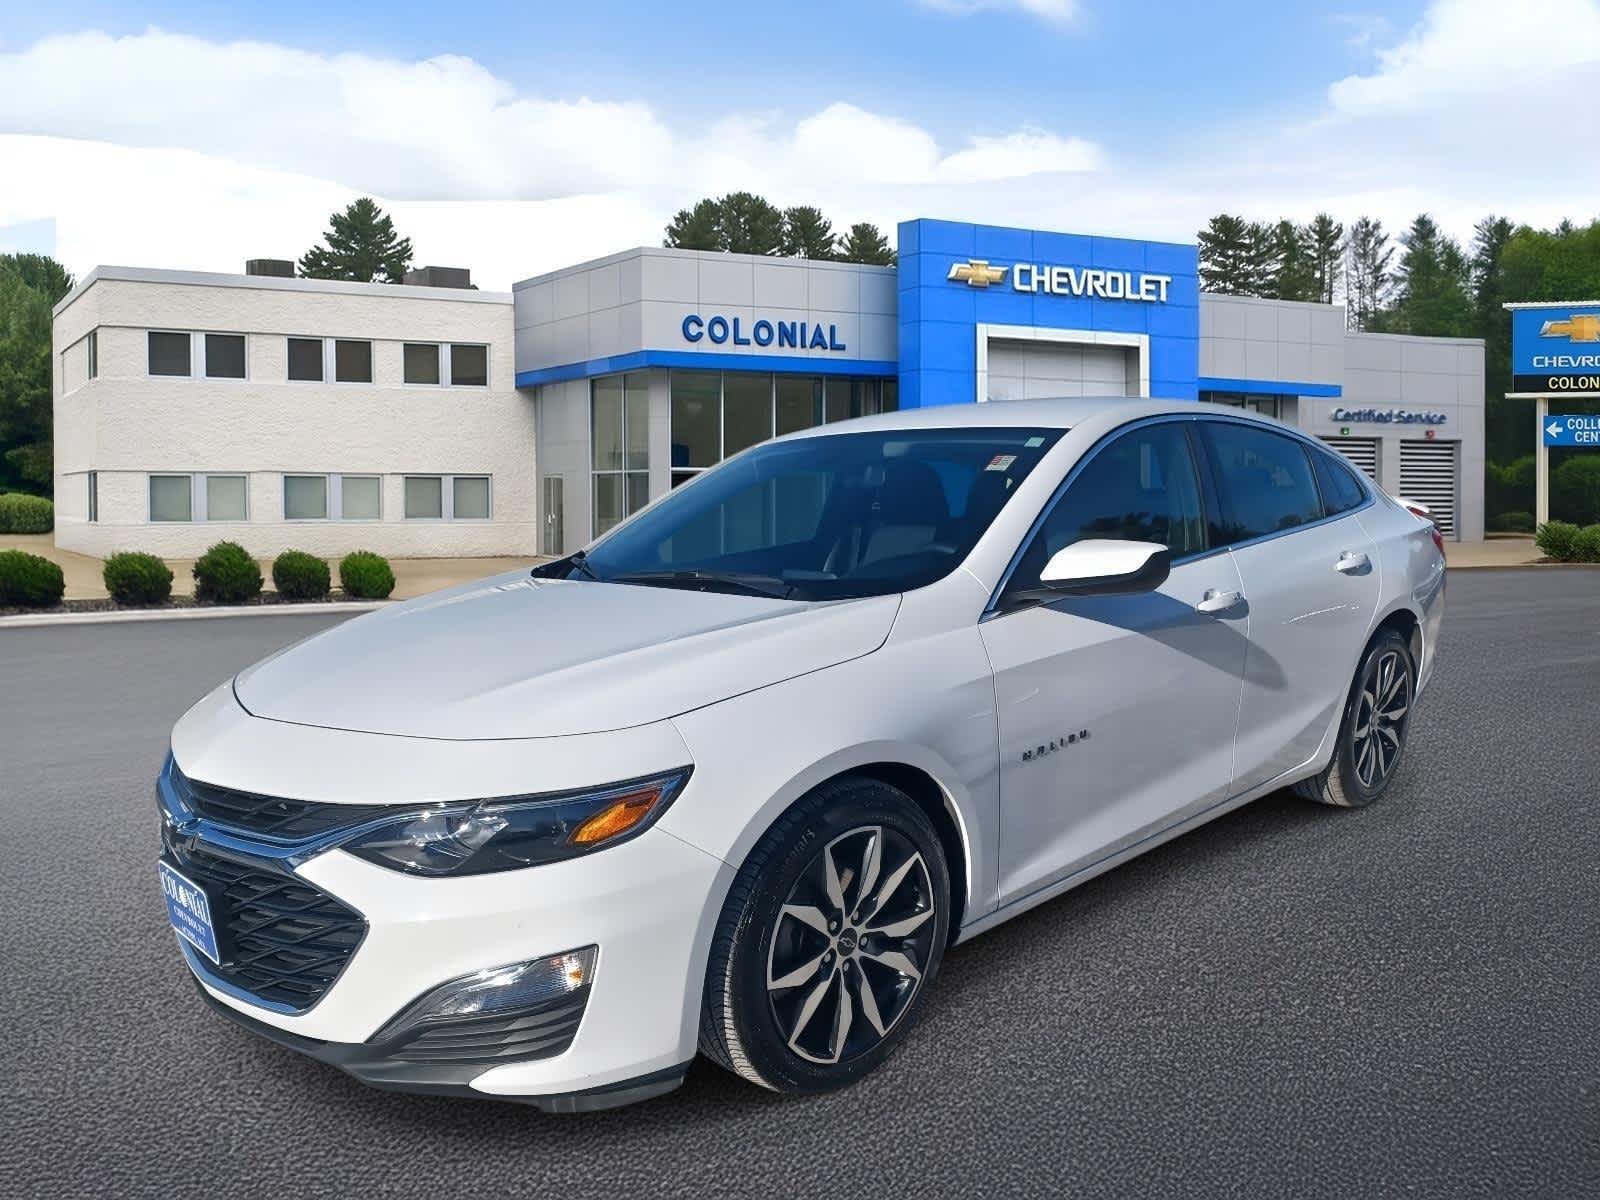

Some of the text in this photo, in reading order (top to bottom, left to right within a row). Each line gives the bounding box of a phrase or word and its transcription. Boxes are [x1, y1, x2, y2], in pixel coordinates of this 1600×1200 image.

[1013, 263, 1171, 303] CHEVROLET
[682, 314, 846, 351] COLONIAL
[1332, 408, 1447, 424] Certified Service
